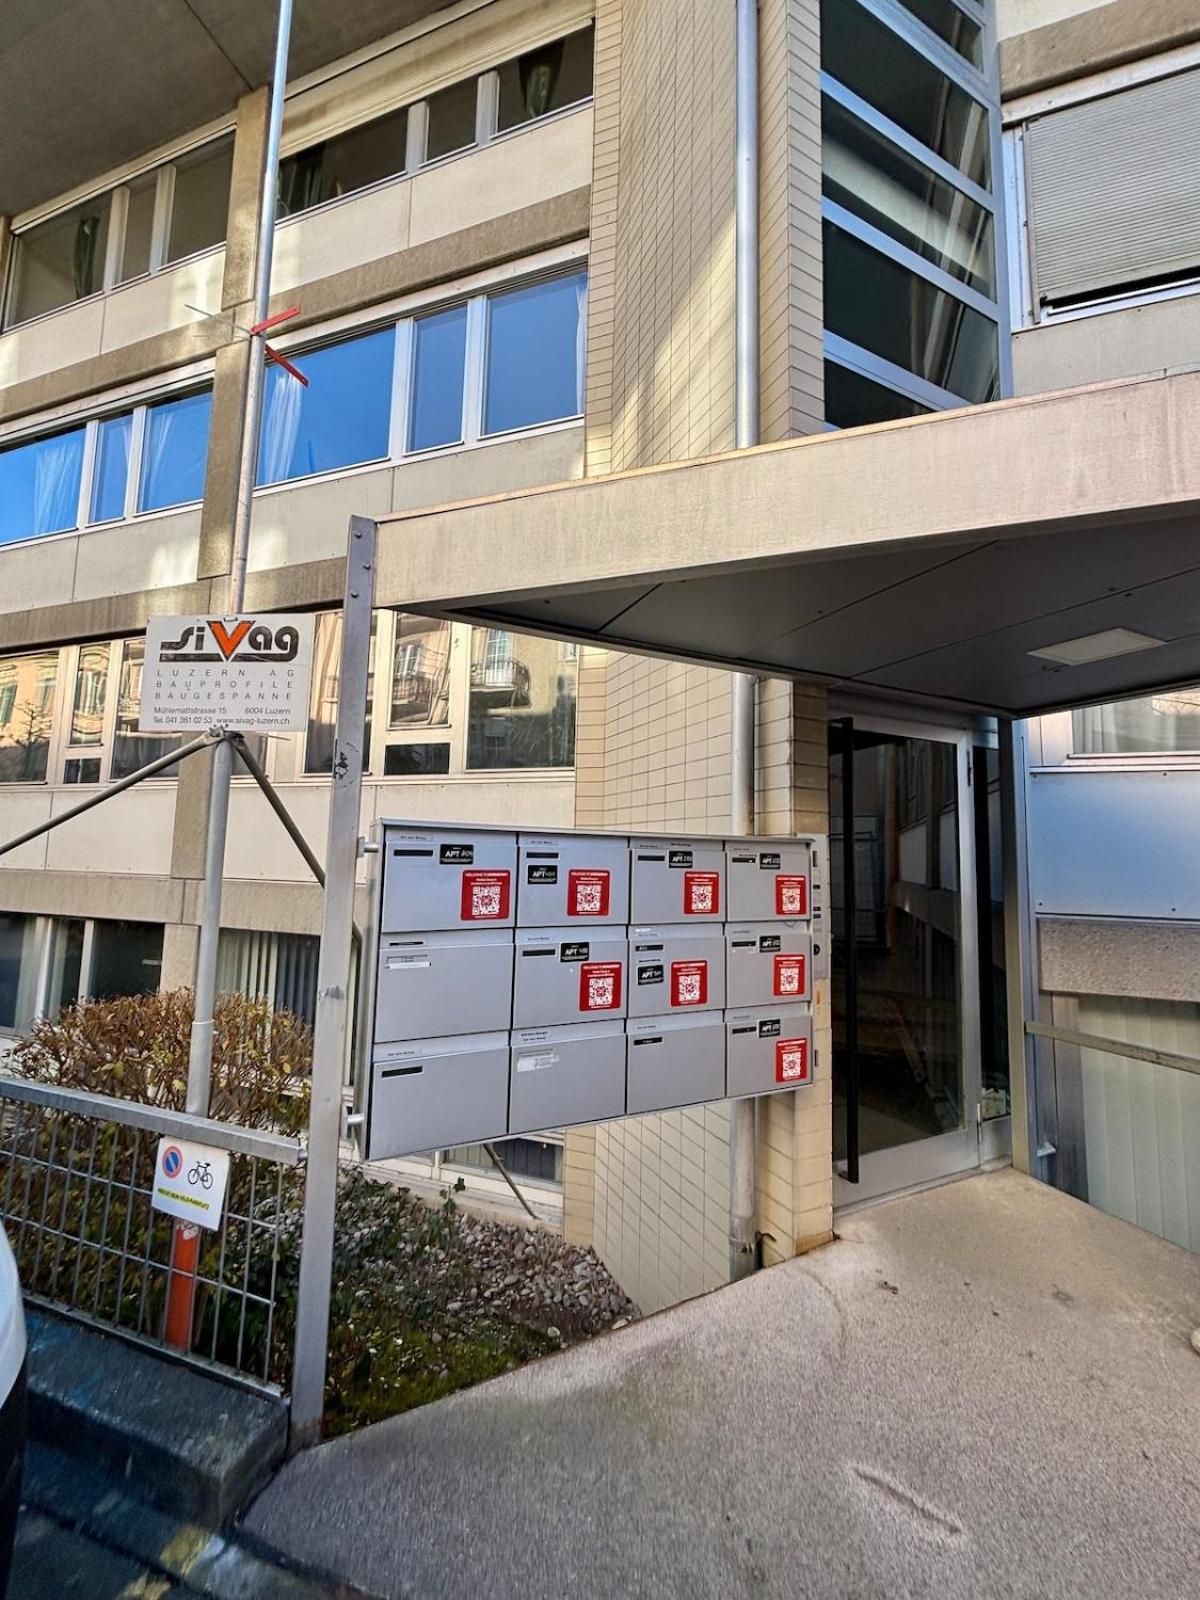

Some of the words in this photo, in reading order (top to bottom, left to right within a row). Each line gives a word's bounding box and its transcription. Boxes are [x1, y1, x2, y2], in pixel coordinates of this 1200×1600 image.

[269, 669, 295, 677] AG
[155, 692, 292, 700] BAUGESPANNE
[265, 707, 291, 715] Luzern
